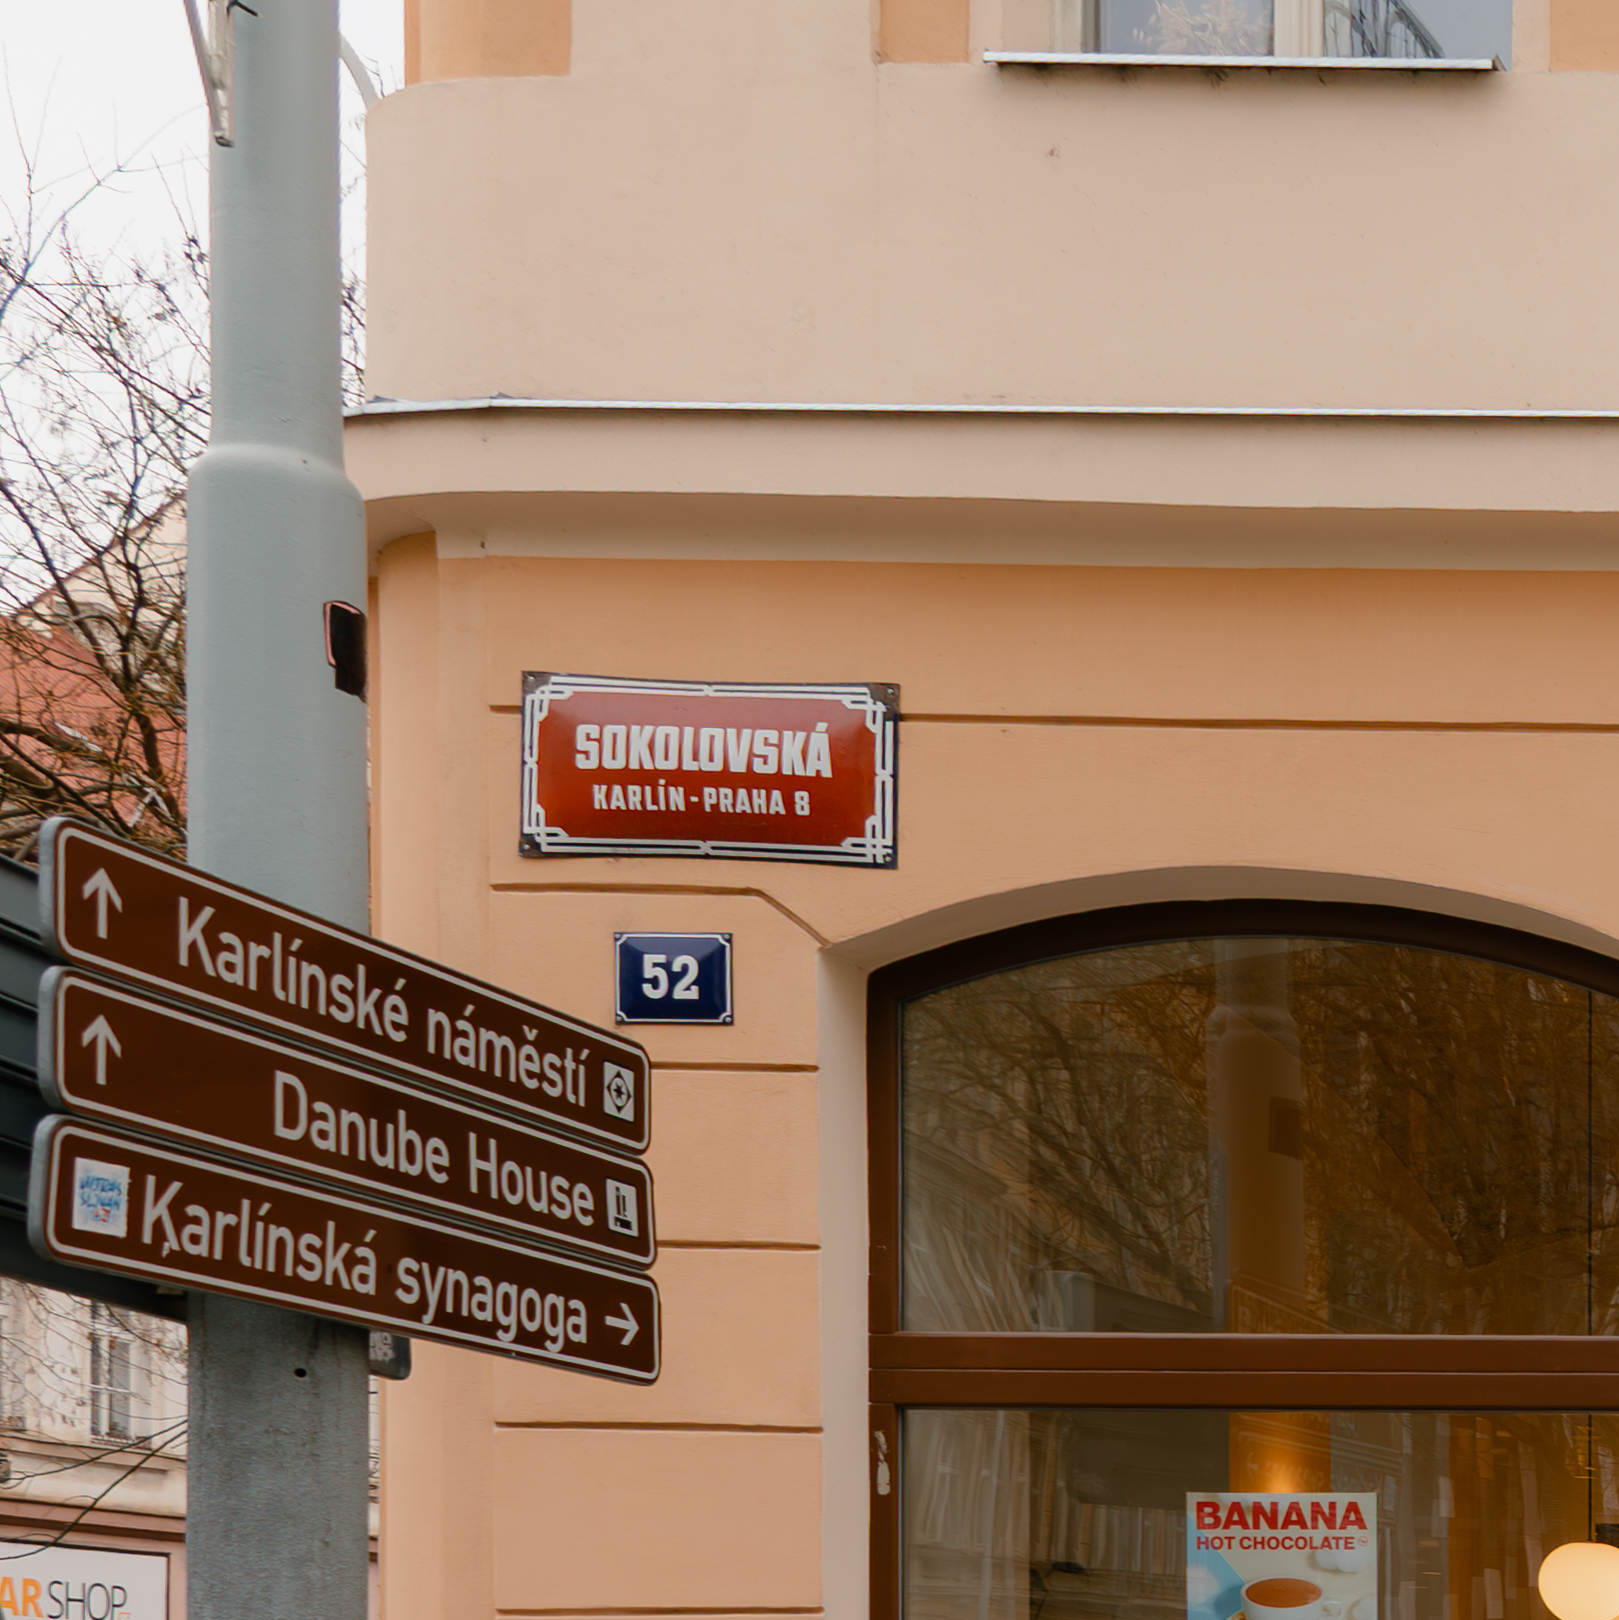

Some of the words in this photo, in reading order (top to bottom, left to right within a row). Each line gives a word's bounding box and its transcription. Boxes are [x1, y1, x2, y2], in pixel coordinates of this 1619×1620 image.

[575, 722, 833, 778] SOKOLOVSKÁ
[592, 778, 687, 812] KARLÍN
[703, 786, 786, 815] PRAHA
[794, 790, 811, 816] 8
[176, 895, 410, 1045] Karlínské
[426, 1007, 588, 1110] náměstí
[641, 954, 701, 1003] 52
[272, 1070, 451, 1186] Danube
[468, 1131, 597, 1228] House
[141, 1173, 378, 1297] Karlínská
[395, 1253, 588, 1354] synagoga
[1195, 1501, 1368, 1531] BANANA
[1196, 1536, 1235, 1551] HOT
[1239, 1536, 1356, 1551] CHOCOLATE
